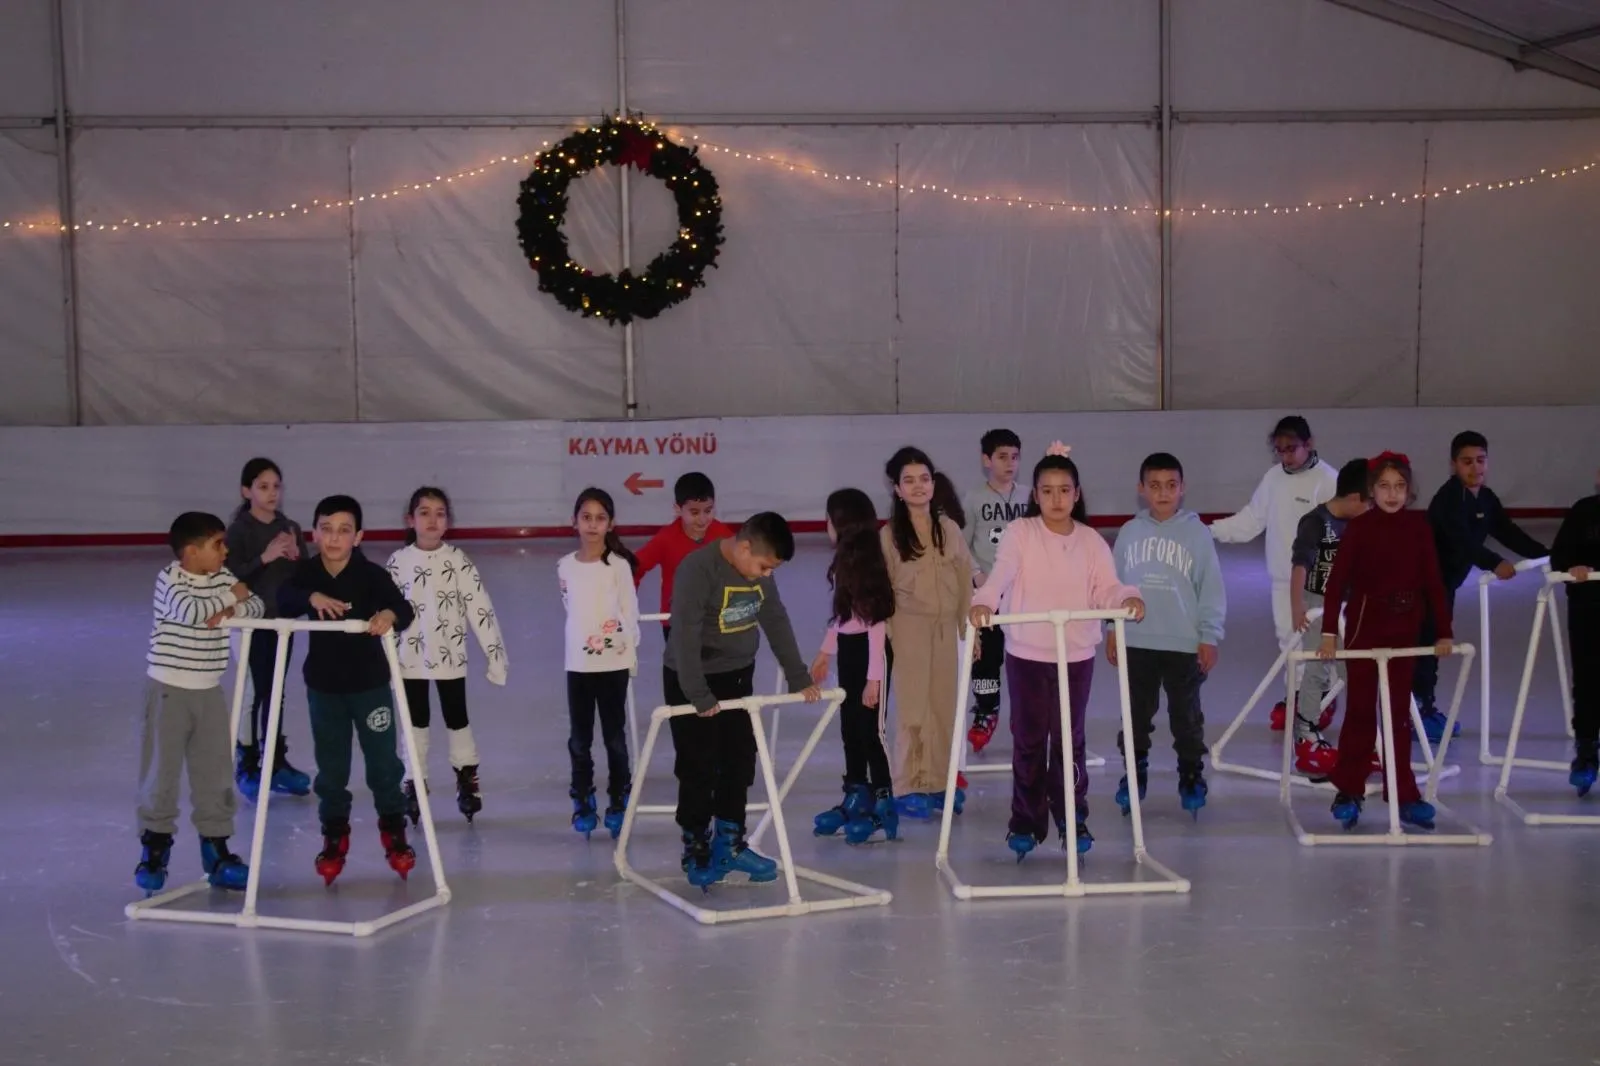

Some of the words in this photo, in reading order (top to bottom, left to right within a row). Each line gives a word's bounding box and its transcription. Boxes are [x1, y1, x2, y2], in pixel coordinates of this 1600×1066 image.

[568, 438, 649, 455] KAYMA
[654, 432, 717, 455] YÖNÜ
[1124, 536, 1193, 577] ALIFORNI
